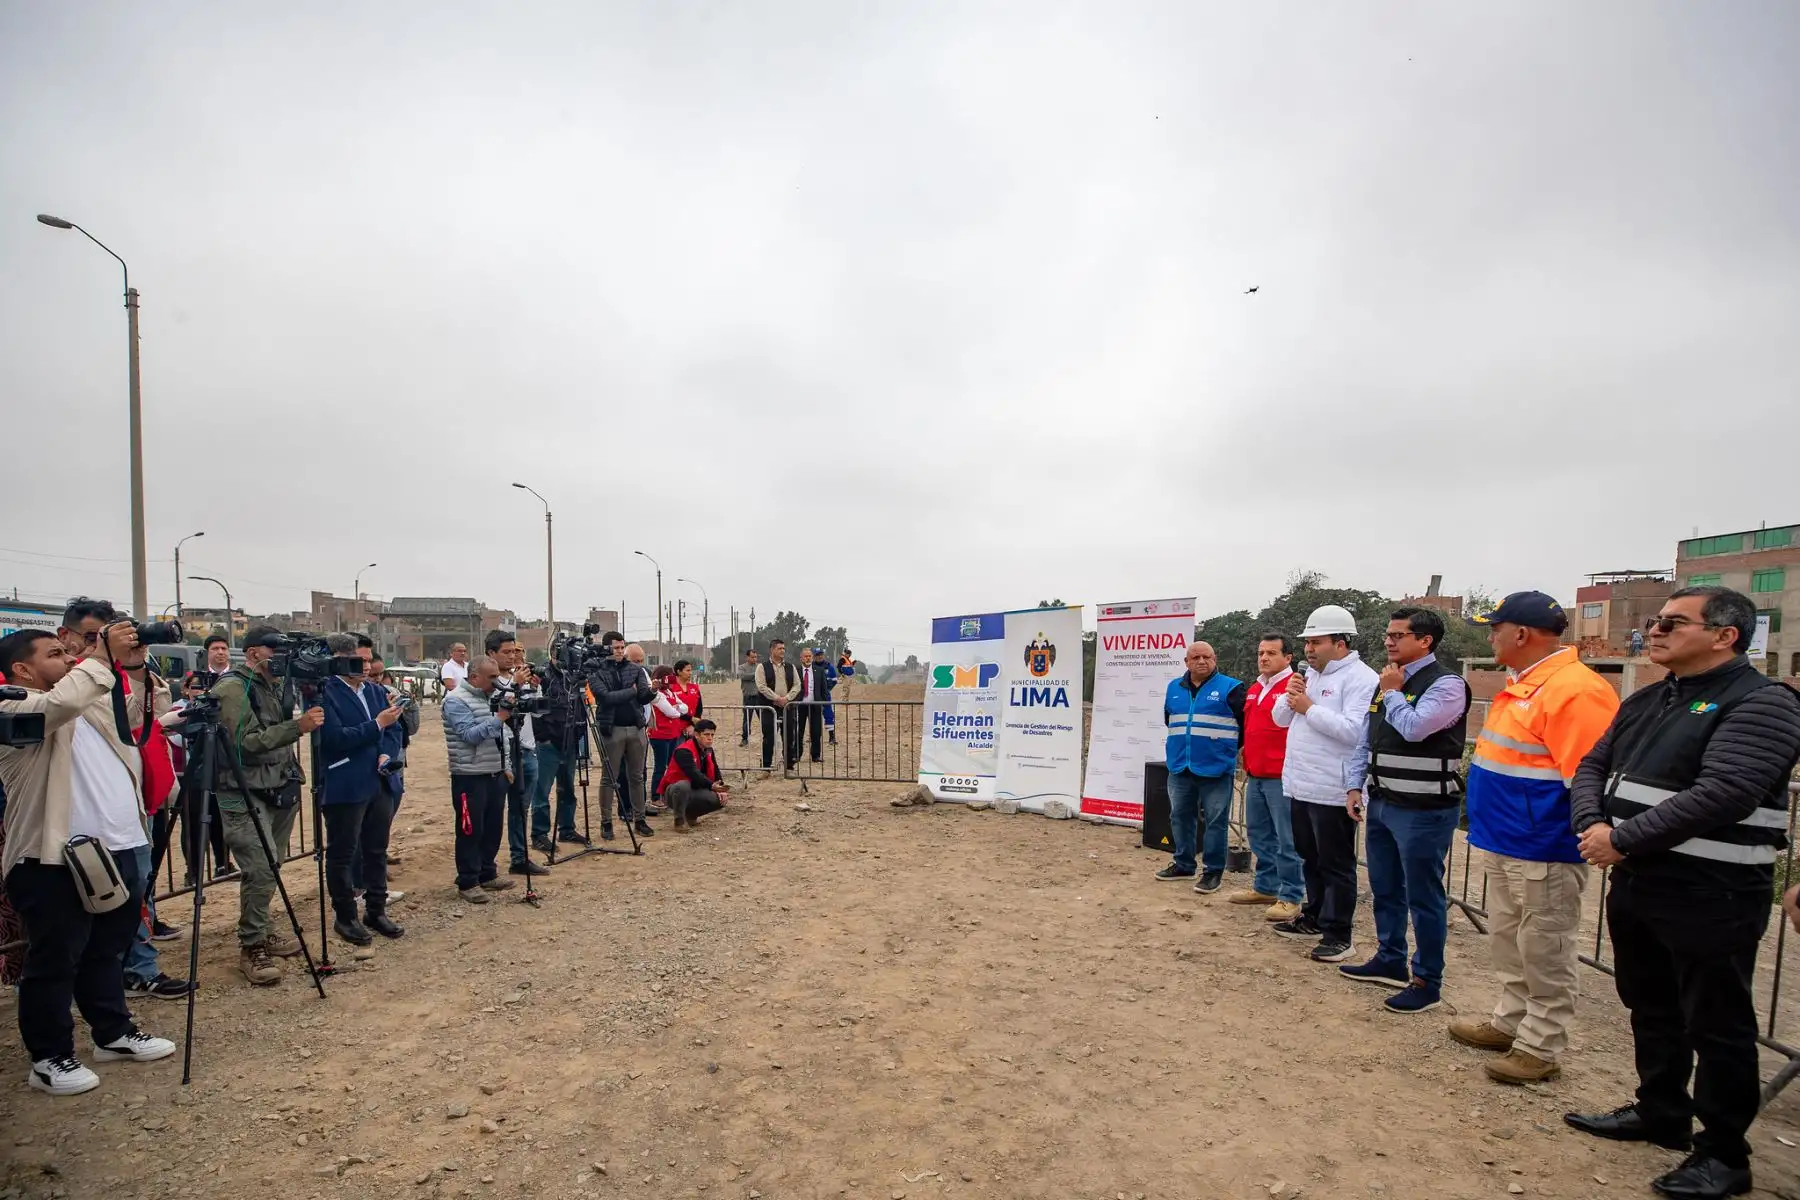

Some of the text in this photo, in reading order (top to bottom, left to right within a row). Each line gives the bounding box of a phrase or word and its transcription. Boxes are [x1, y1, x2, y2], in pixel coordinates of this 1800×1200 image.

[1103, 633, 1186, 651] VIVIENDA
[931, 663, 1000, 689] SMP
[1010, 687, 1070, 708] LIMA
[932, 727, 994, 740] Sifuentes
[1057, 724, 1074, 732] Riesgo
